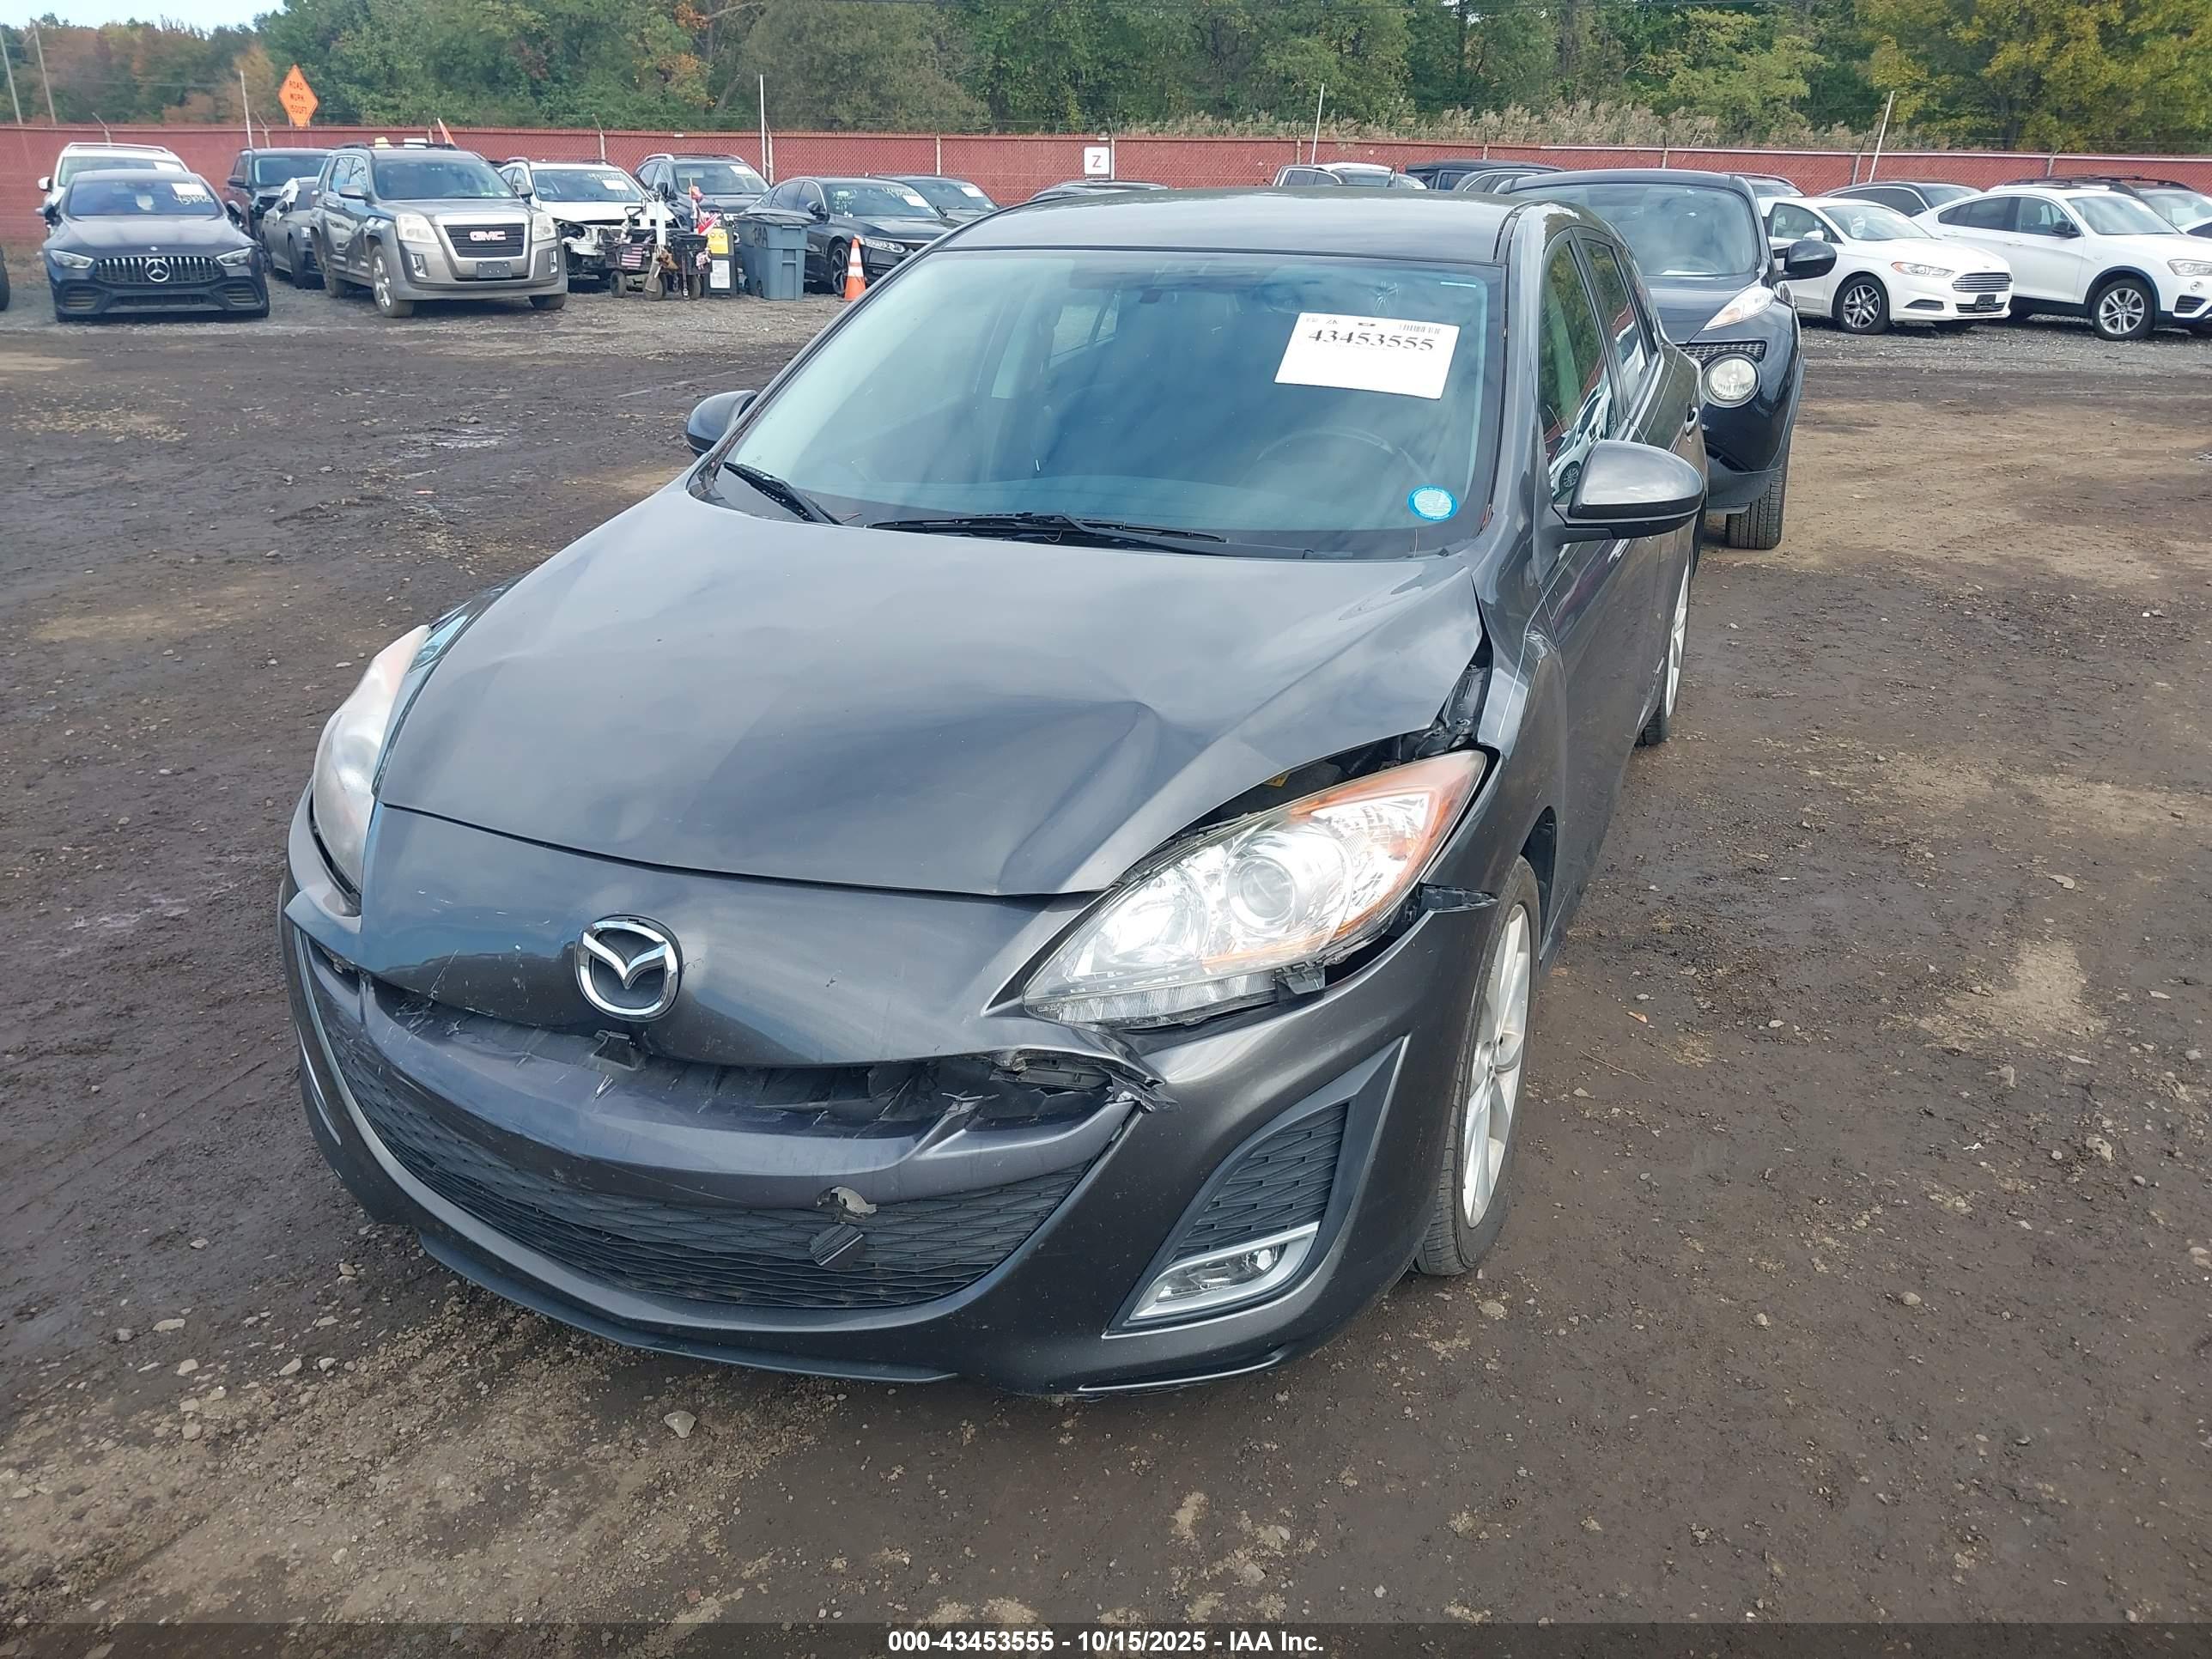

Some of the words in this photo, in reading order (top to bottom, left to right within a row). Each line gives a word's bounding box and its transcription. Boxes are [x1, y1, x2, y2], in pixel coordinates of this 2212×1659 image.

[1091, 155, 1102, 168] Z
[470, 231, 507, 241] GMC
[1308, 329, 1435, 351] 43453555
